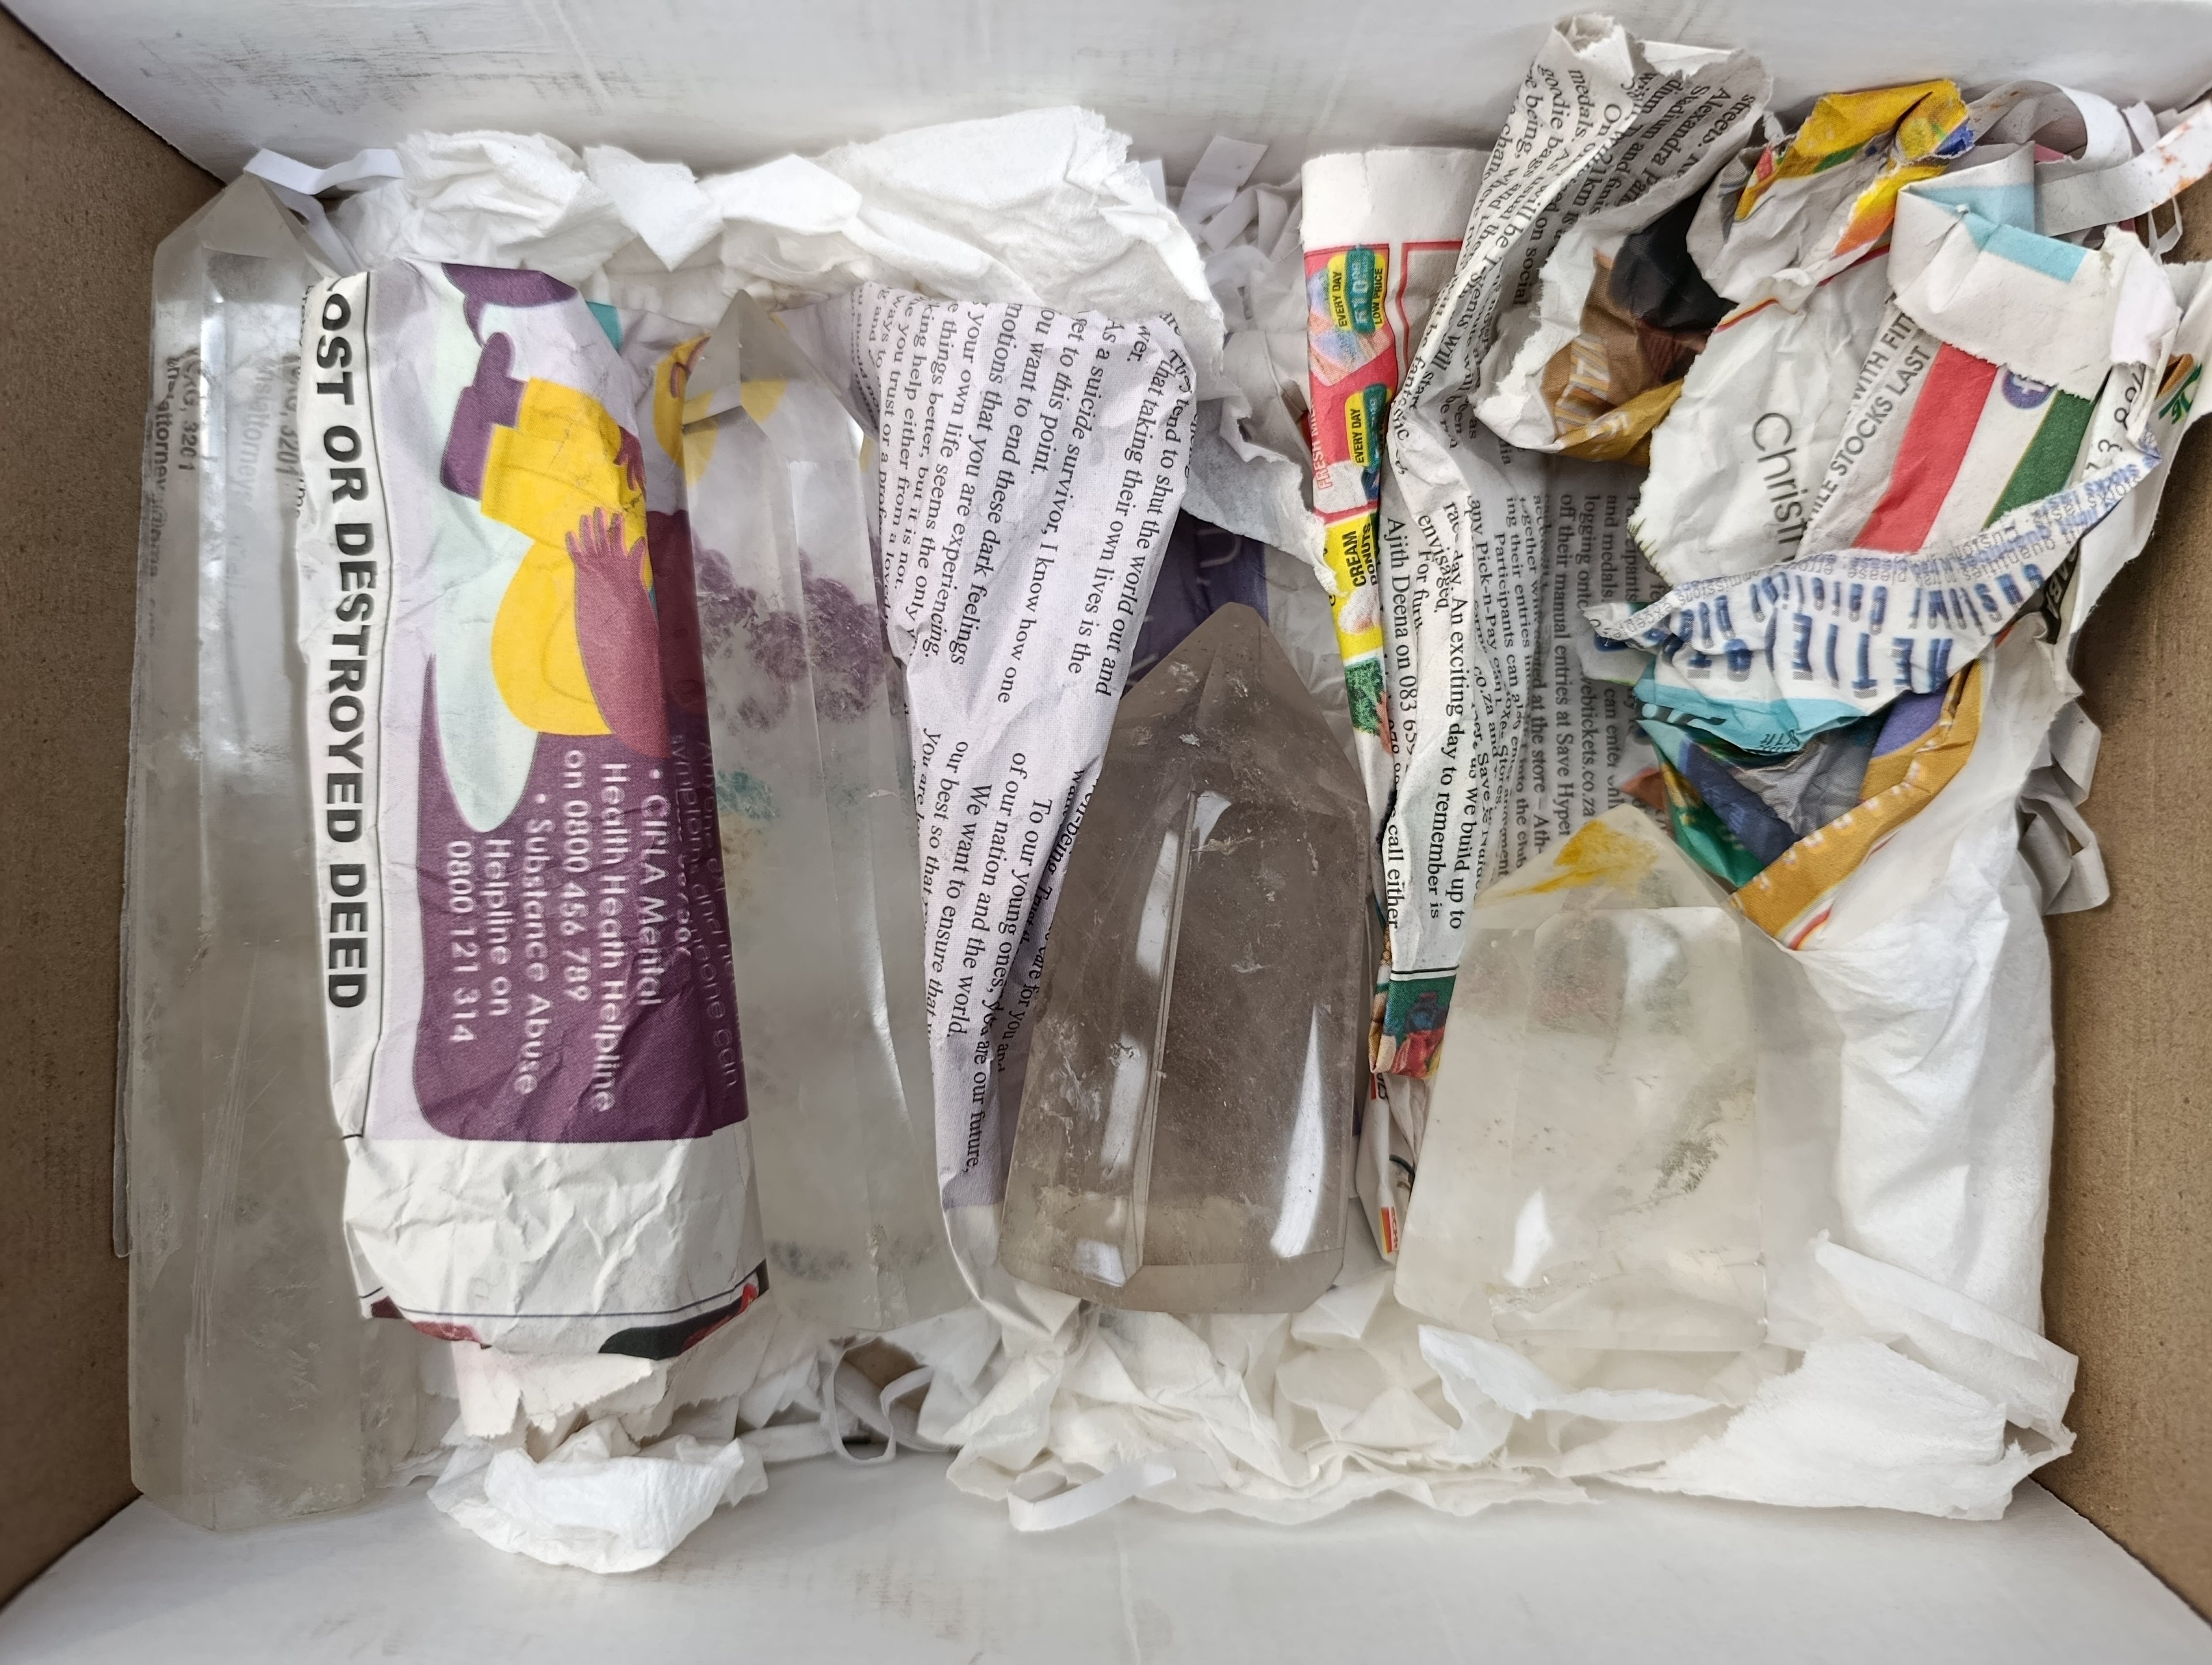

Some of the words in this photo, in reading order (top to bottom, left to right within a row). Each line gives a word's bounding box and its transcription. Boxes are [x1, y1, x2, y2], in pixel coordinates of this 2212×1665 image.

[1536, 65, 1570, 131] goodie
[1567, 70, 1594, 144] medals.
[1596, 104, 1622, 137] On
[1641, 85, 1710, 140] Stadium
[1697, 94, 1756, 148] streets.
[1513, 94, 1543, 160] being,
[1650, 88, 1731, 168] Alexandra
[1521, 135, 1564, 179] bags
[1612, 142, 1646, 174] and
[1487, 183, 1521, 211] and
[1497, 176, 1544, 221] usual
[1560, 212, 1578, 226] is
[1494, 223, 1524, 249] be
[1530, 216, 1549, 241] on
[1331, 270, 1342, 291] DAY
[1373, 267, 1382, 298] PRICE
[1511, 248, 1540, 306] social
[1332, 294, 1348, 327] EVERY
[1372, 301, 1382, 324] LOW
[316, 283, 354, 405] OST
[892, 323, 910, 363] you
[929, 320, 957, 385] things
[961, 311, 986, 363] your
[1058, 347, 1080, 367] to
[902, 354, 927, 401] help
[1020, 343, 1044, 390] want
[1147, 359, 1173, 397] that
[883, 371, 902, 418] trust
[950, 369, 971, 416] own
[976, 390, 1002, 433] that
[1013, 397, 1033, 418] to
[1048, 373, 1072, 411] this
[1071, 366, 1101, 440] suicide
[1407, 371, 1434, 411] start
[1830, 396, 1893, 476] STOCKS
[1885, 346, 1931, 397] LAST
[898, 408, 916, 471] either
[918, 393, 943, 458] better,
[939, 423, 963, 459] life
[1123, 400, 1158, 464] taking
[1164, 399, 1189, 443] tend
[1350, 408, 1361, 428] DAY
[323, 425, 369, 504] OR
[964, 434, 988, 477] you
[1001, 424, 1023, 466] end
[1029, 413, 1057, 476] point.
[1160, 450, 1177, 469] to
[1312, 440, 1332, 490] FRESH
[1352, 430, 1365, 463] EVERY
[892, 476, 909, 526] from
[912, 466, 929, 501] but
[925, 463, 948, 530] seems
[956, 483, 975, 517] are
[987, 469, 1014, 525] these
[1040, 443, 1081, 535] survivor,
[1114, 469, 1142, 517] their
[1146, 475, 1172, 515] shut
[1559, 494, 1574, 522] off
[1575, 495, 1599, 565] logging
[1603, 495, 1618, 528] and
[917, 537, 936, 569] the
[972, 529, 1000, 578] dark
[1098, 521, 1123, 561] own
[1135, 520, 1159, 549] the
[1361, 522, 1378, 585] DONUTS
[1382, 517, 1409, 570] Ajith
[1509, 534, 1521, 579] their
[1555, 525, 1573, 568] their
[1341, 530, 1367, 587] CREAM
[1416, 515, 1450, 614] envisaged.
[1599, 533, 1616, 604] medals.
[904, 575, 927, 623] only
[921, 523, 967, 659] experiencing.
[1024, 557, 1054, 613] know
[1084, 567, 1115, 613] lives
[1116, 556, 1146, 616] world
[1390, 574, 1410, 640] Deena
[1474, 541, 1498, 651] Pick-n-Pay
[1552, 573, 1571, 639] manual
[948, 583, 987, 665] feelings
[1449, 597, 1467, 625] An
[1493, 533, 1513, 648] Participants
[1505, 654, 1518, 688] can
[1513, 584, 1530, 648] entries
[1009, 619, 1036, 661] how
[1067, 643, 1091, 674] the
[1105, 619, 1124, 654] out
[1395, 644, 1409, 671] on
[327, 523, 377, 843] DESTROYED
[997, 666, 1017, 704] one
[1094, 657, 1115, 697] and
[1398, 676, 1418, 712] 083
[1446, 631, 1469, 717] exciting
[1554, 644, 1572, 706] entries
[1556, 711, 1569, 728] at
[1603, 688, 1618, 719] can
[1440, 722, 1464, 760] day
[1531, 716, 1546, 745] the
[563, 750, 586, 789] on
[945, 741, 968, 773] our
[1009, 752, 1027, 779] of
[1440, 766, 1456, 786] to
[1531, 749, 1546, 794] store
[1555, 733, 1573, 777] Save
[600, 763, 630, 864] Health
[933, 778, 960, 821] best
[965, 784, 992, 816] We
[999, 780, 1018, 817] our
[1028, 799, 1052, 824] To
[1515, 798, 1528, 826] the
[562, 799, 590, 873] 0800
[639, 795, 668, 885] CIPLA
[928, 825, 944, 849] so
[951, 822, 977, 874] want
[980, 821, 1007, 886] nation
[1019, 830, 1039, 866] our
[1386, 824, 1404, 862] call
[1426, 792, 1452, 896] remember
[1453, 821, 1476, 873] build
[446, 840, 476, 913] 0800
[922, 855, 940, 896] that
[946, 879, 966, 899] to
[1385, 868, 1404, 929] either
[1445, 878, 1465, 903] up
[480, 839, 513, 965] Helpline
[522, 819, 555, 981] Substance
[559, 881, 589, 936] 456
[599, 875, 629, 969] Heath
[971, 892, 990, 932] and
[998, 869, 1029, 936] young
[1448, 909, 1465, 930] to
[329, 864, 368, 1008] DEED
[451, 928, 479, 973] 121
[637, 897, 665, 1005] Mental
[930, 905, 955, 974] ensure
[962, 937, 984, 969] the
[563, 947, 591, 1002] 789
[986, 942, 1013, 993] ones,
[451, 987, 478, 1042] 314
[487, 976, 510, 1017] on
[946, 975, 973, 1038] world.
[513, 993, 552, 1094] Abuse
[591, 980, 626, 1112] Helpline
[971, 1072, 987, 1105] our
[961, 1109, 986, 1174] future,
